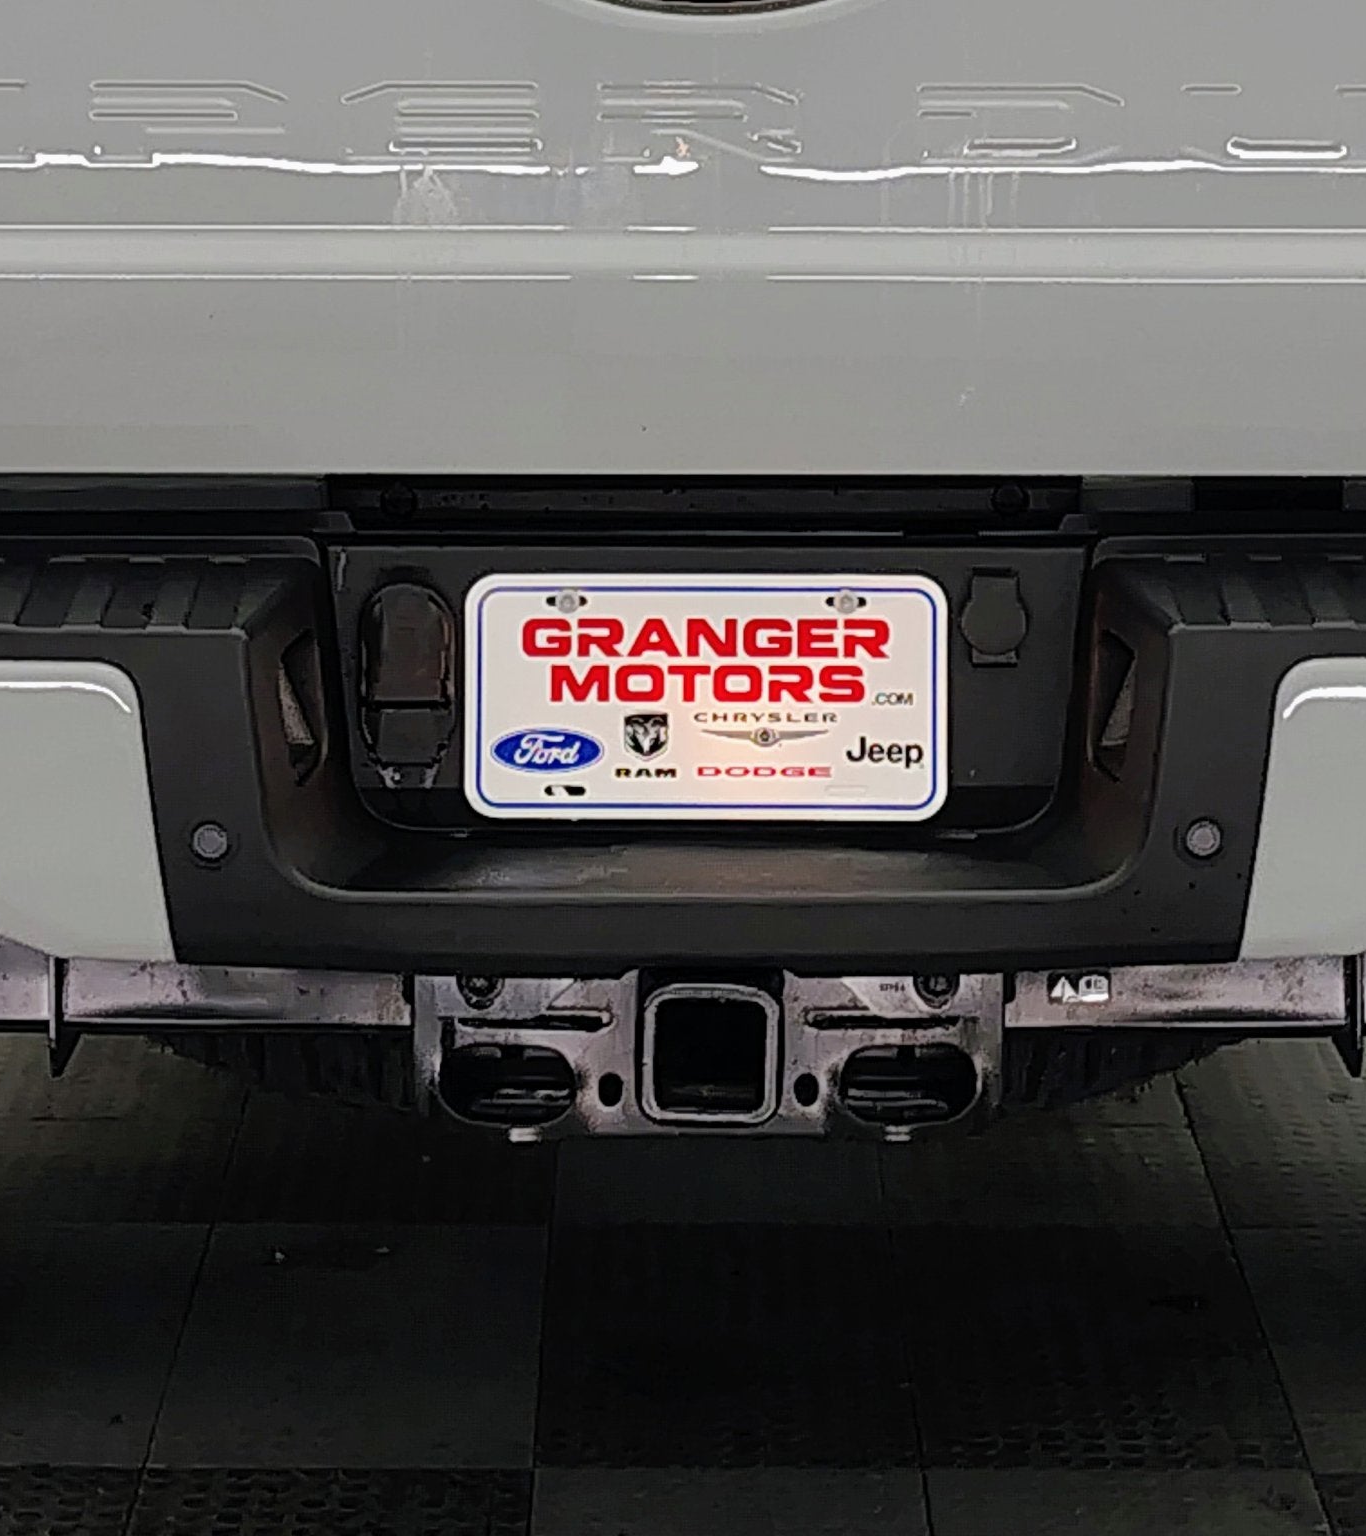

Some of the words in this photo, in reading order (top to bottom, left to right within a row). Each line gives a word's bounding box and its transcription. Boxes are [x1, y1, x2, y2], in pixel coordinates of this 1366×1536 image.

[521, 618, 890, 659] GRANGER
[550, 665, 865, 703] MOTORS
[693, 712, 838, 723] CHRYSLER
[513, 735, 579, 765] Ford
[846, 736, 924, 768] Jeep
[614, 767, 677, 778] RAM
[697, 766, 833, 778] DODGE
